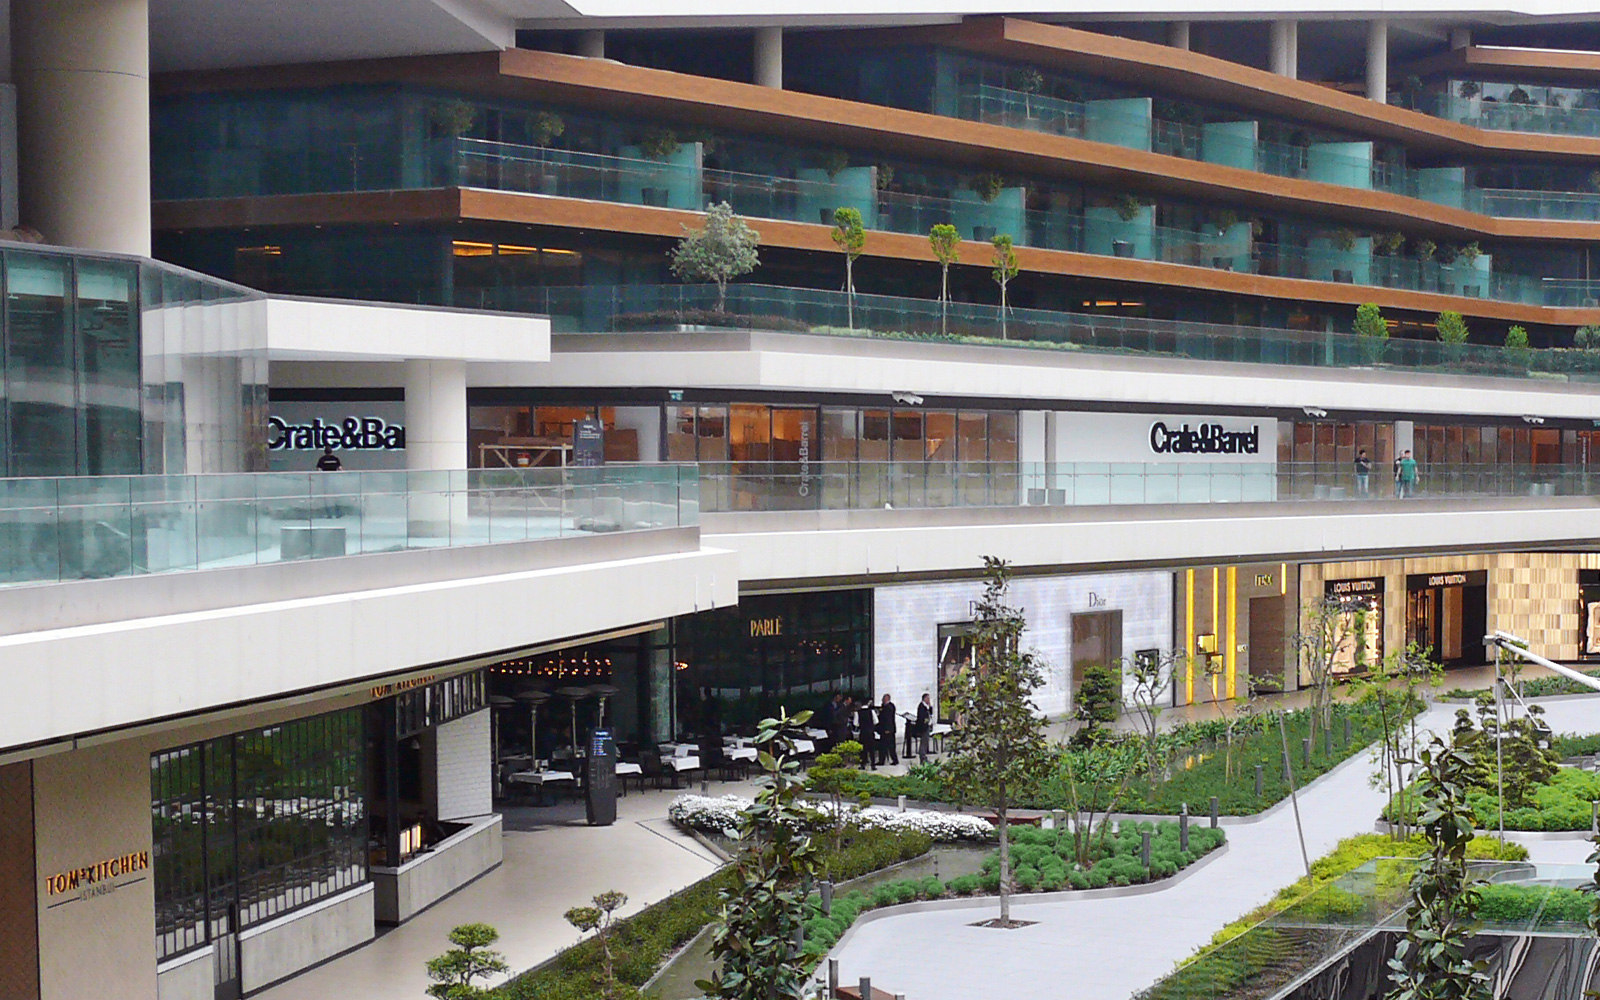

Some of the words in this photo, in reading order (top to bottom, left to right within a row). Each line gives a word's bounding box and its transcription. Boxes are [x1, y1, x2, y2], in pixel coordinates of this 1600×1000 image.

[268, 417, 405, 450] Crate&Ba
[1149, 421, 1259, 454] Crate&Barrel
[1333, 582, 1351, 593] LOUIS
[1352, 580, 1376, 591] VUITTON
[1428, 575, 1444, 586] LOUIS
[1088, 591, 1106, 608] Dior
[86, 851, 149, 884] KITCHEN
